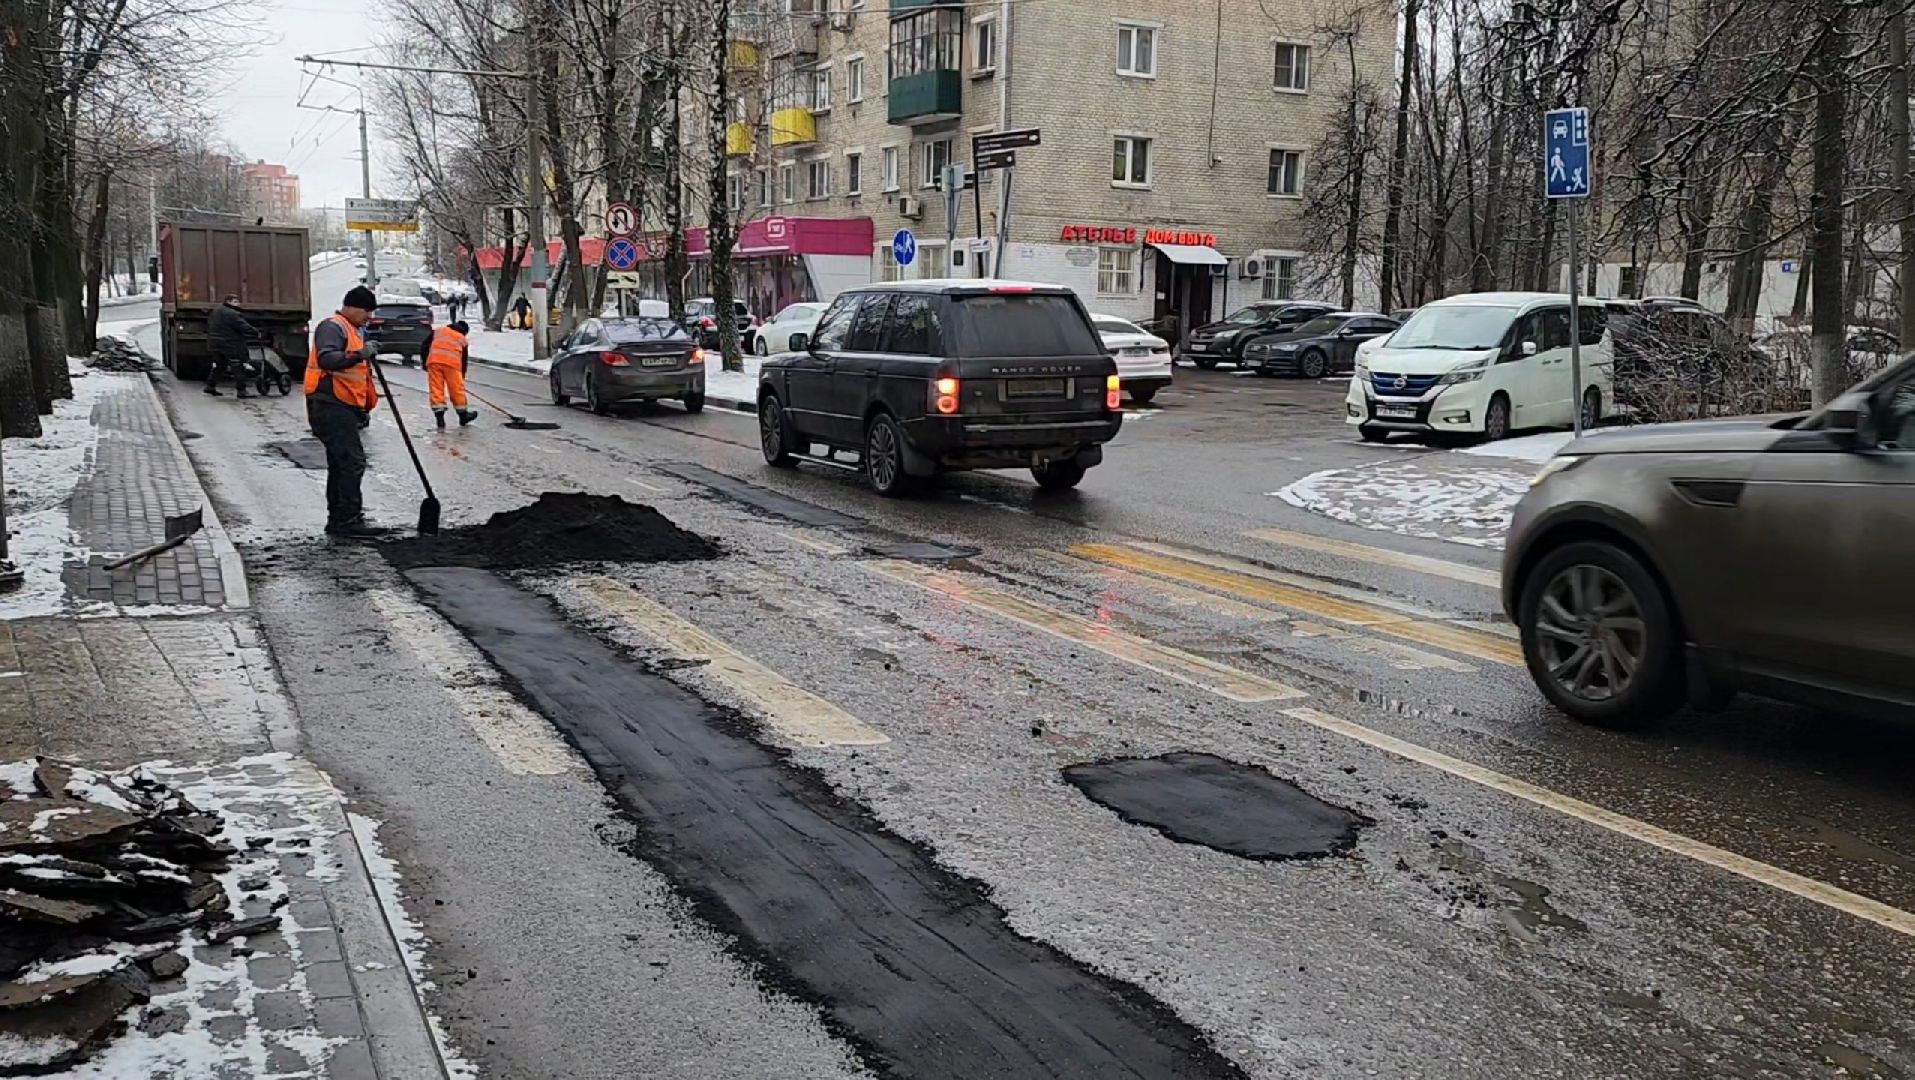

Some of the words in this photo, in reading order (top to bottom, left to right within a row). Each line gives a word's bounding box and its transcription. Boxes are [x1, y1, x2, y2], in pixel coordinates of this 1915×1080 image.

[1061, 225, 1136, 243] АТЕЛЬЕ
[1146, 229, 1175, 244] ДОМ
[992, 366, 1035, 374] RANGE
[1041, 365, 1081, 373] ROVER
